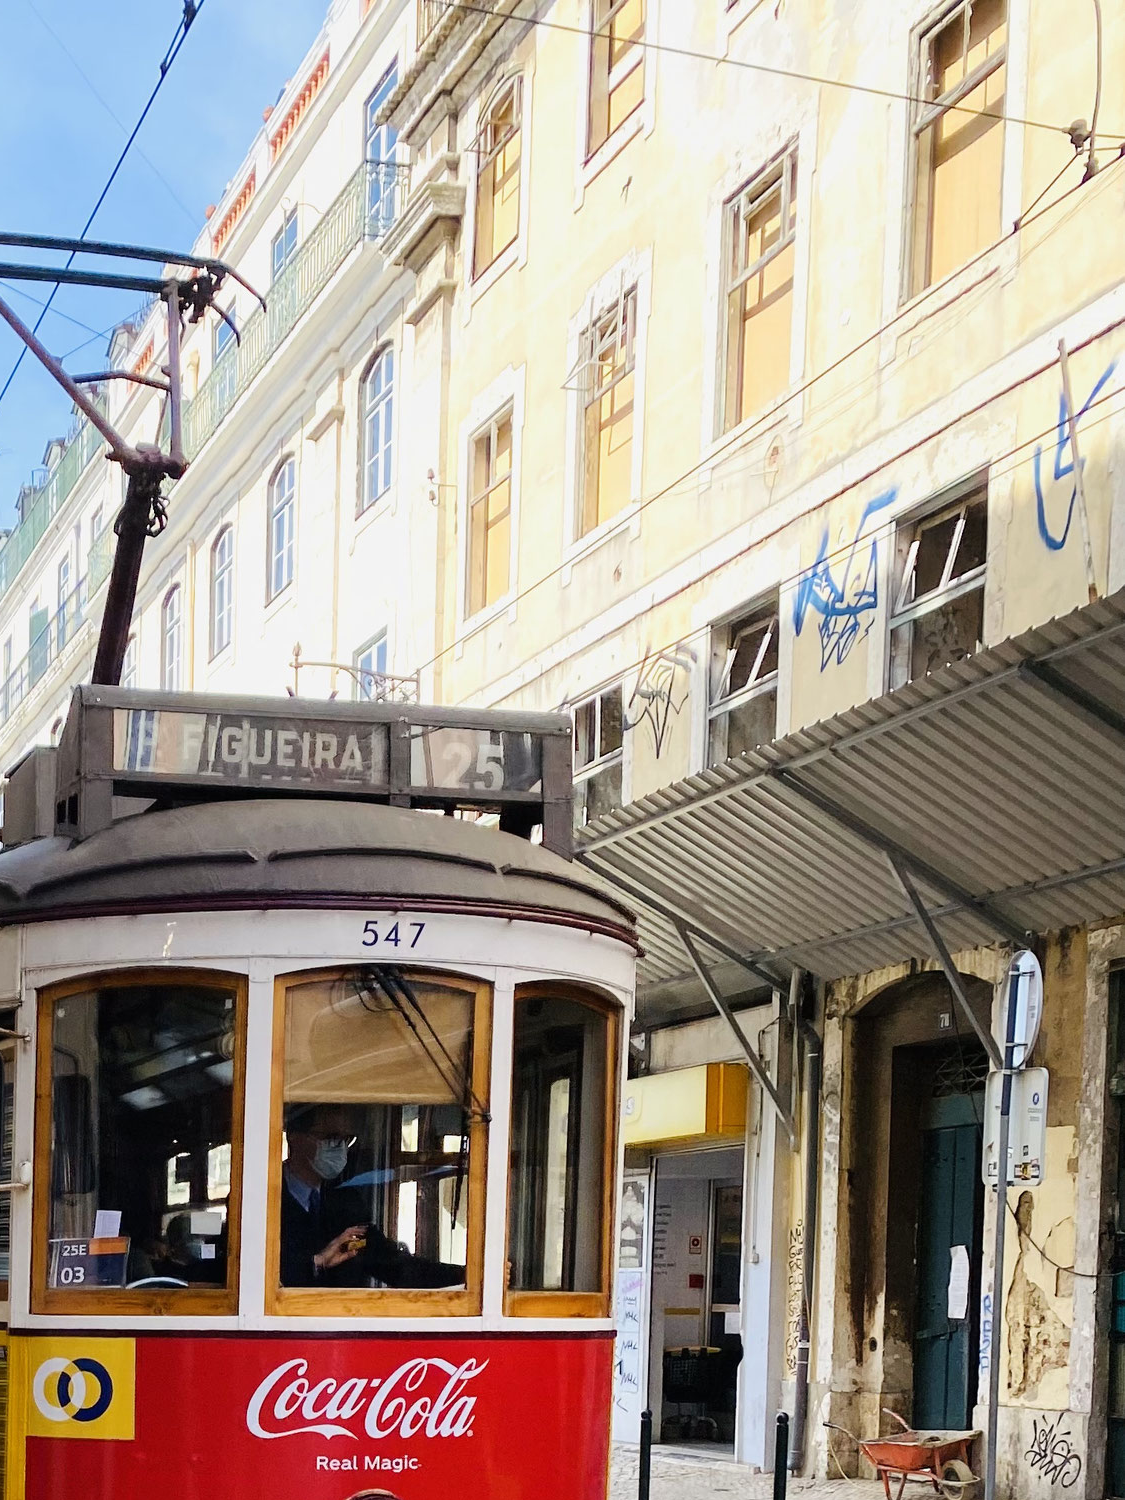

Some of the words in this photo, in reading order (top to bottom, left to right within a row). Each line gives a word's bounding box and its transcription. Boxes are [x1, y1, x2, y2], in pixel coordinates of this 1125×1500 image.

[183, 721, 364, 771] FIGUEIRA
[442, 742, 505, 790] 25
[361, 920, 426, 948] 547
[62, 1243, 87, 1257] 25E
[60, 1266, 85, 1284] 03
[246, 1357, 490, 1441] Coca-Cola
[316, 1455, 358, 1471] Real
[364, 1454, 420, 1473] Magic
